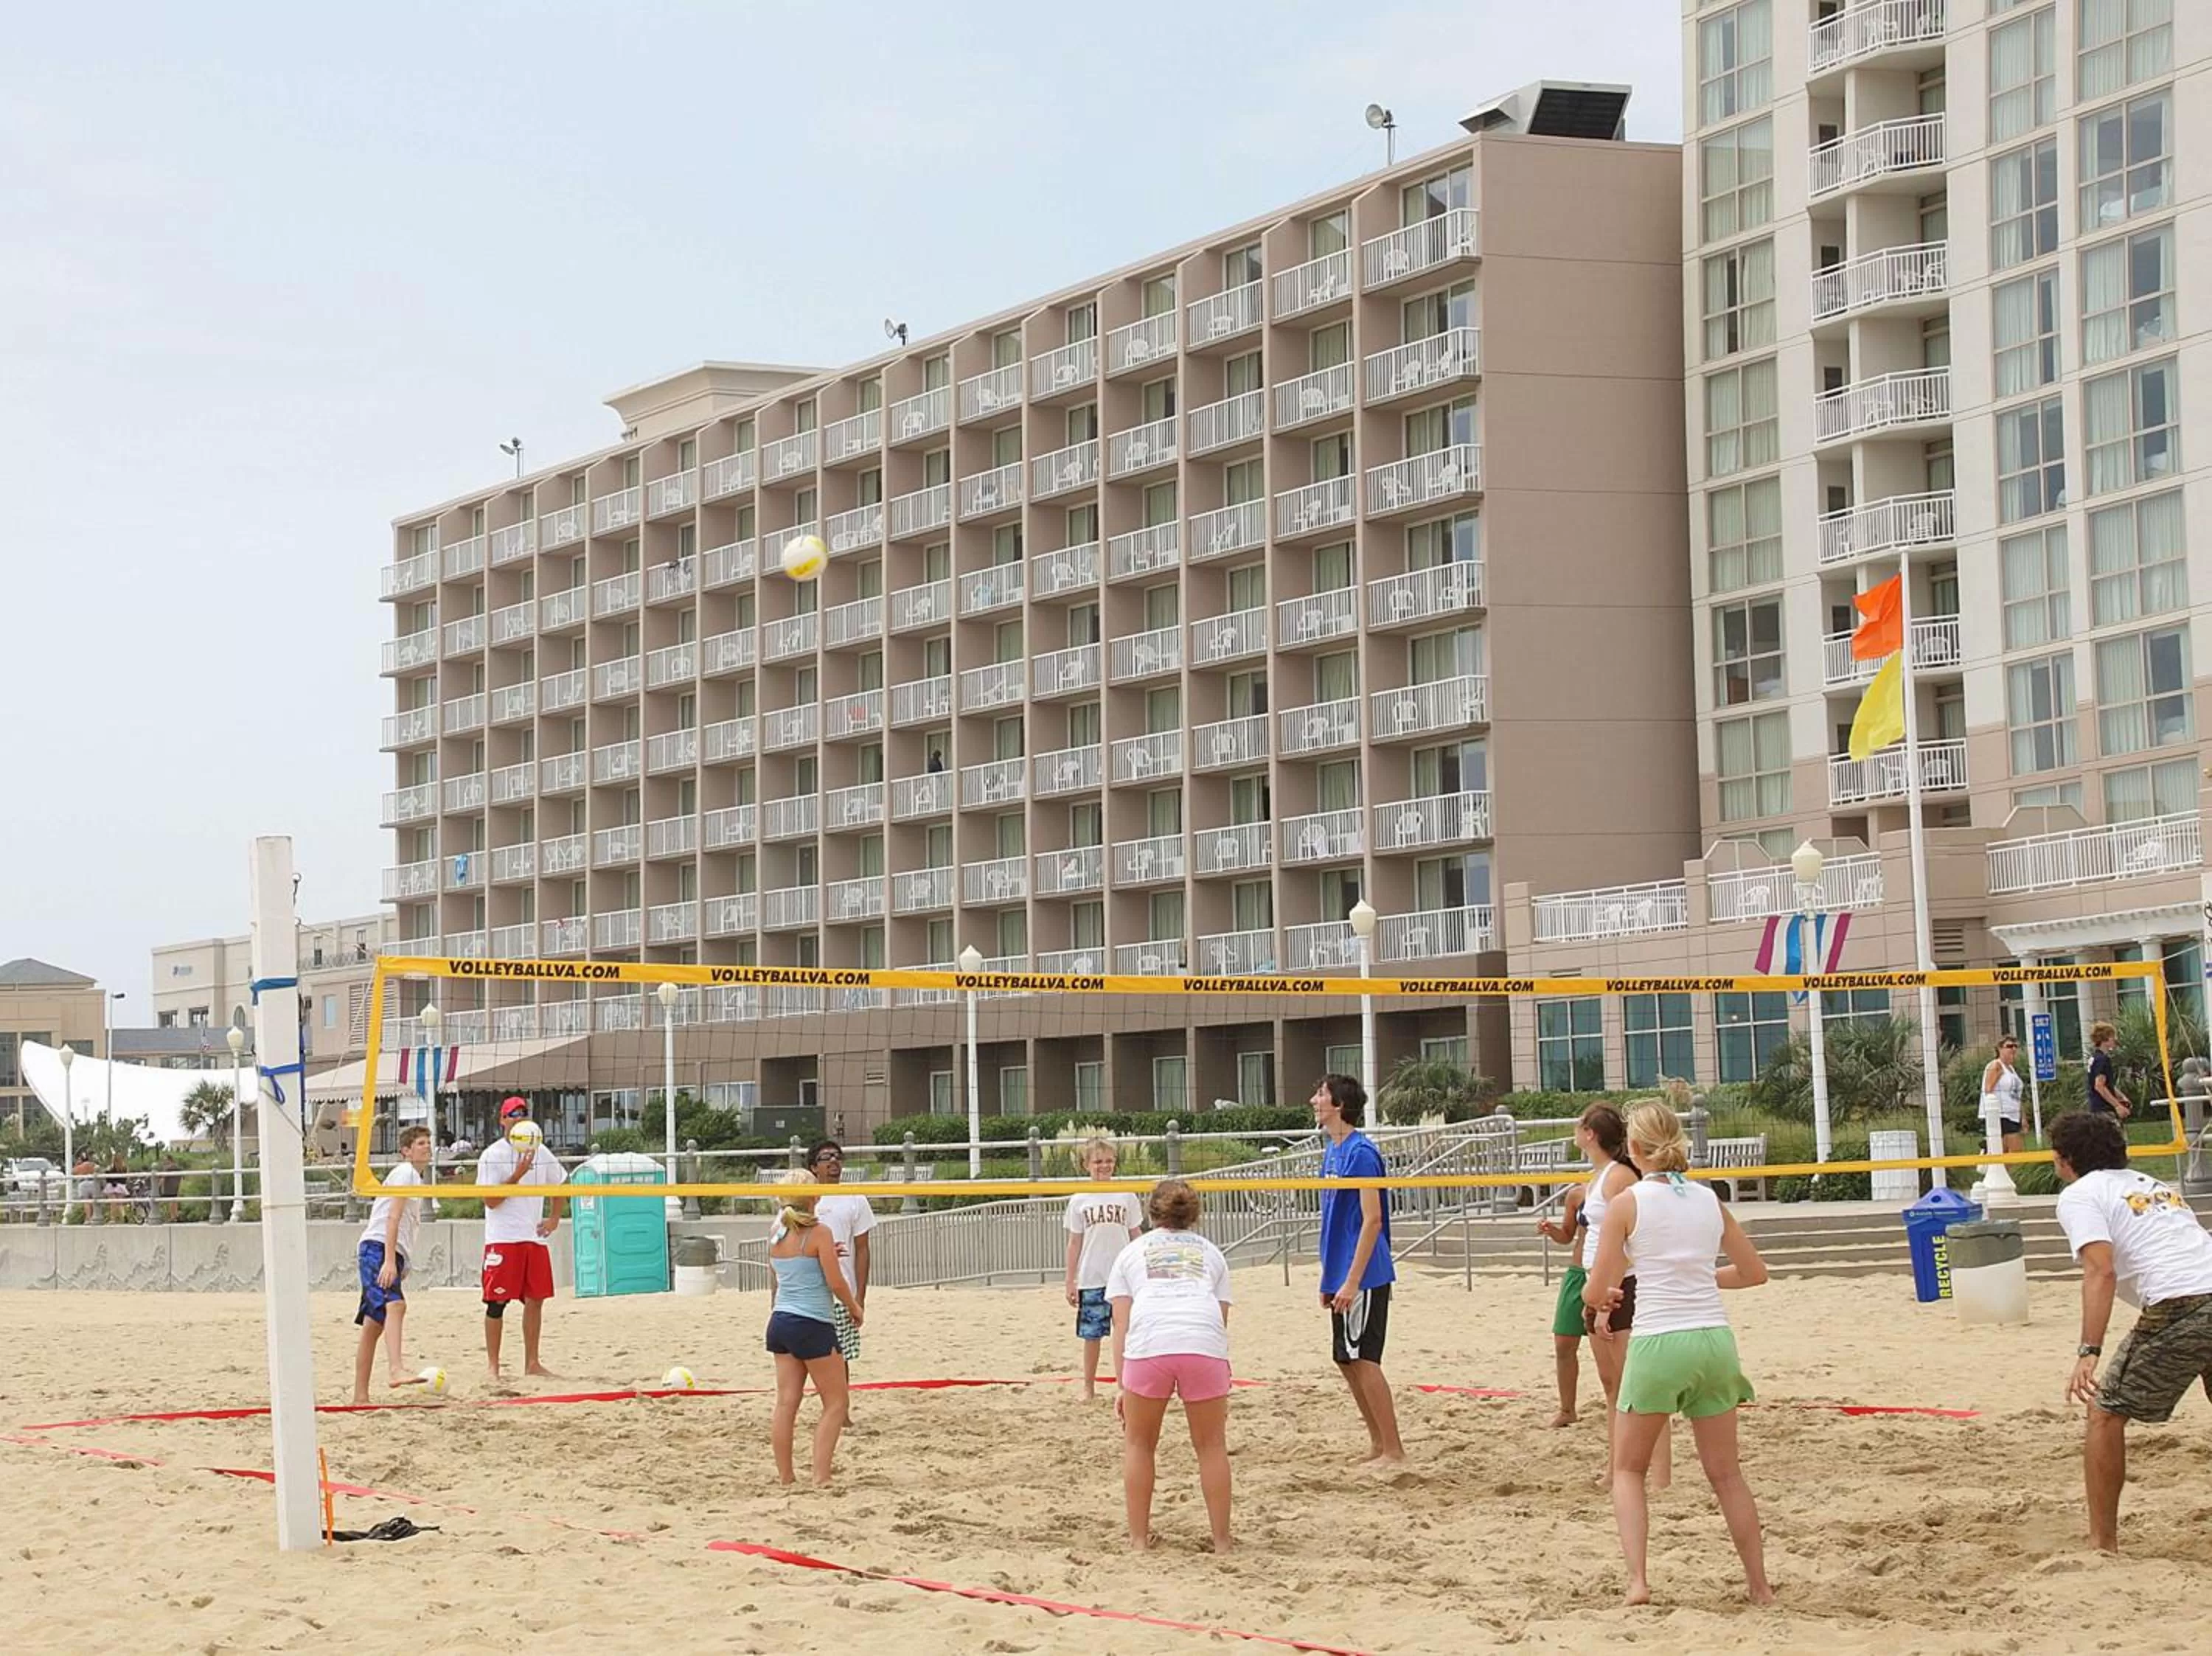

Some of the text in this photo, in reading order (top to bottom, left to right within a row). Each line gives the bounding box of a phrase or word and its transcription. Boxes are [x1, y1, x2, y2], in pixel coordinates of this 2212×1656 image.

[449, 960, 620, 978] VOLLEYBALLVA.COM
[1992, 966, 2112, 981] VOLLEYBALLVA.COM
[711, 969, 870, 986] VOLLEYBALLVA.COM
[956, 975, 1105, 990] VOLLEYBALLVA.COM
[1606, 978, 1734, 992] VOLLEYBALLVA.COM
[1803, 973, 1927, 989] VOLLEYBALLVA.COM
[1183, 979, 1324, 992] VOLLEYBALLVA.COM
[1399, 980, 1534, 992] VOLLEYBALLVA.COM
[1933, 1235, 1952, 1298] RECYCLE
